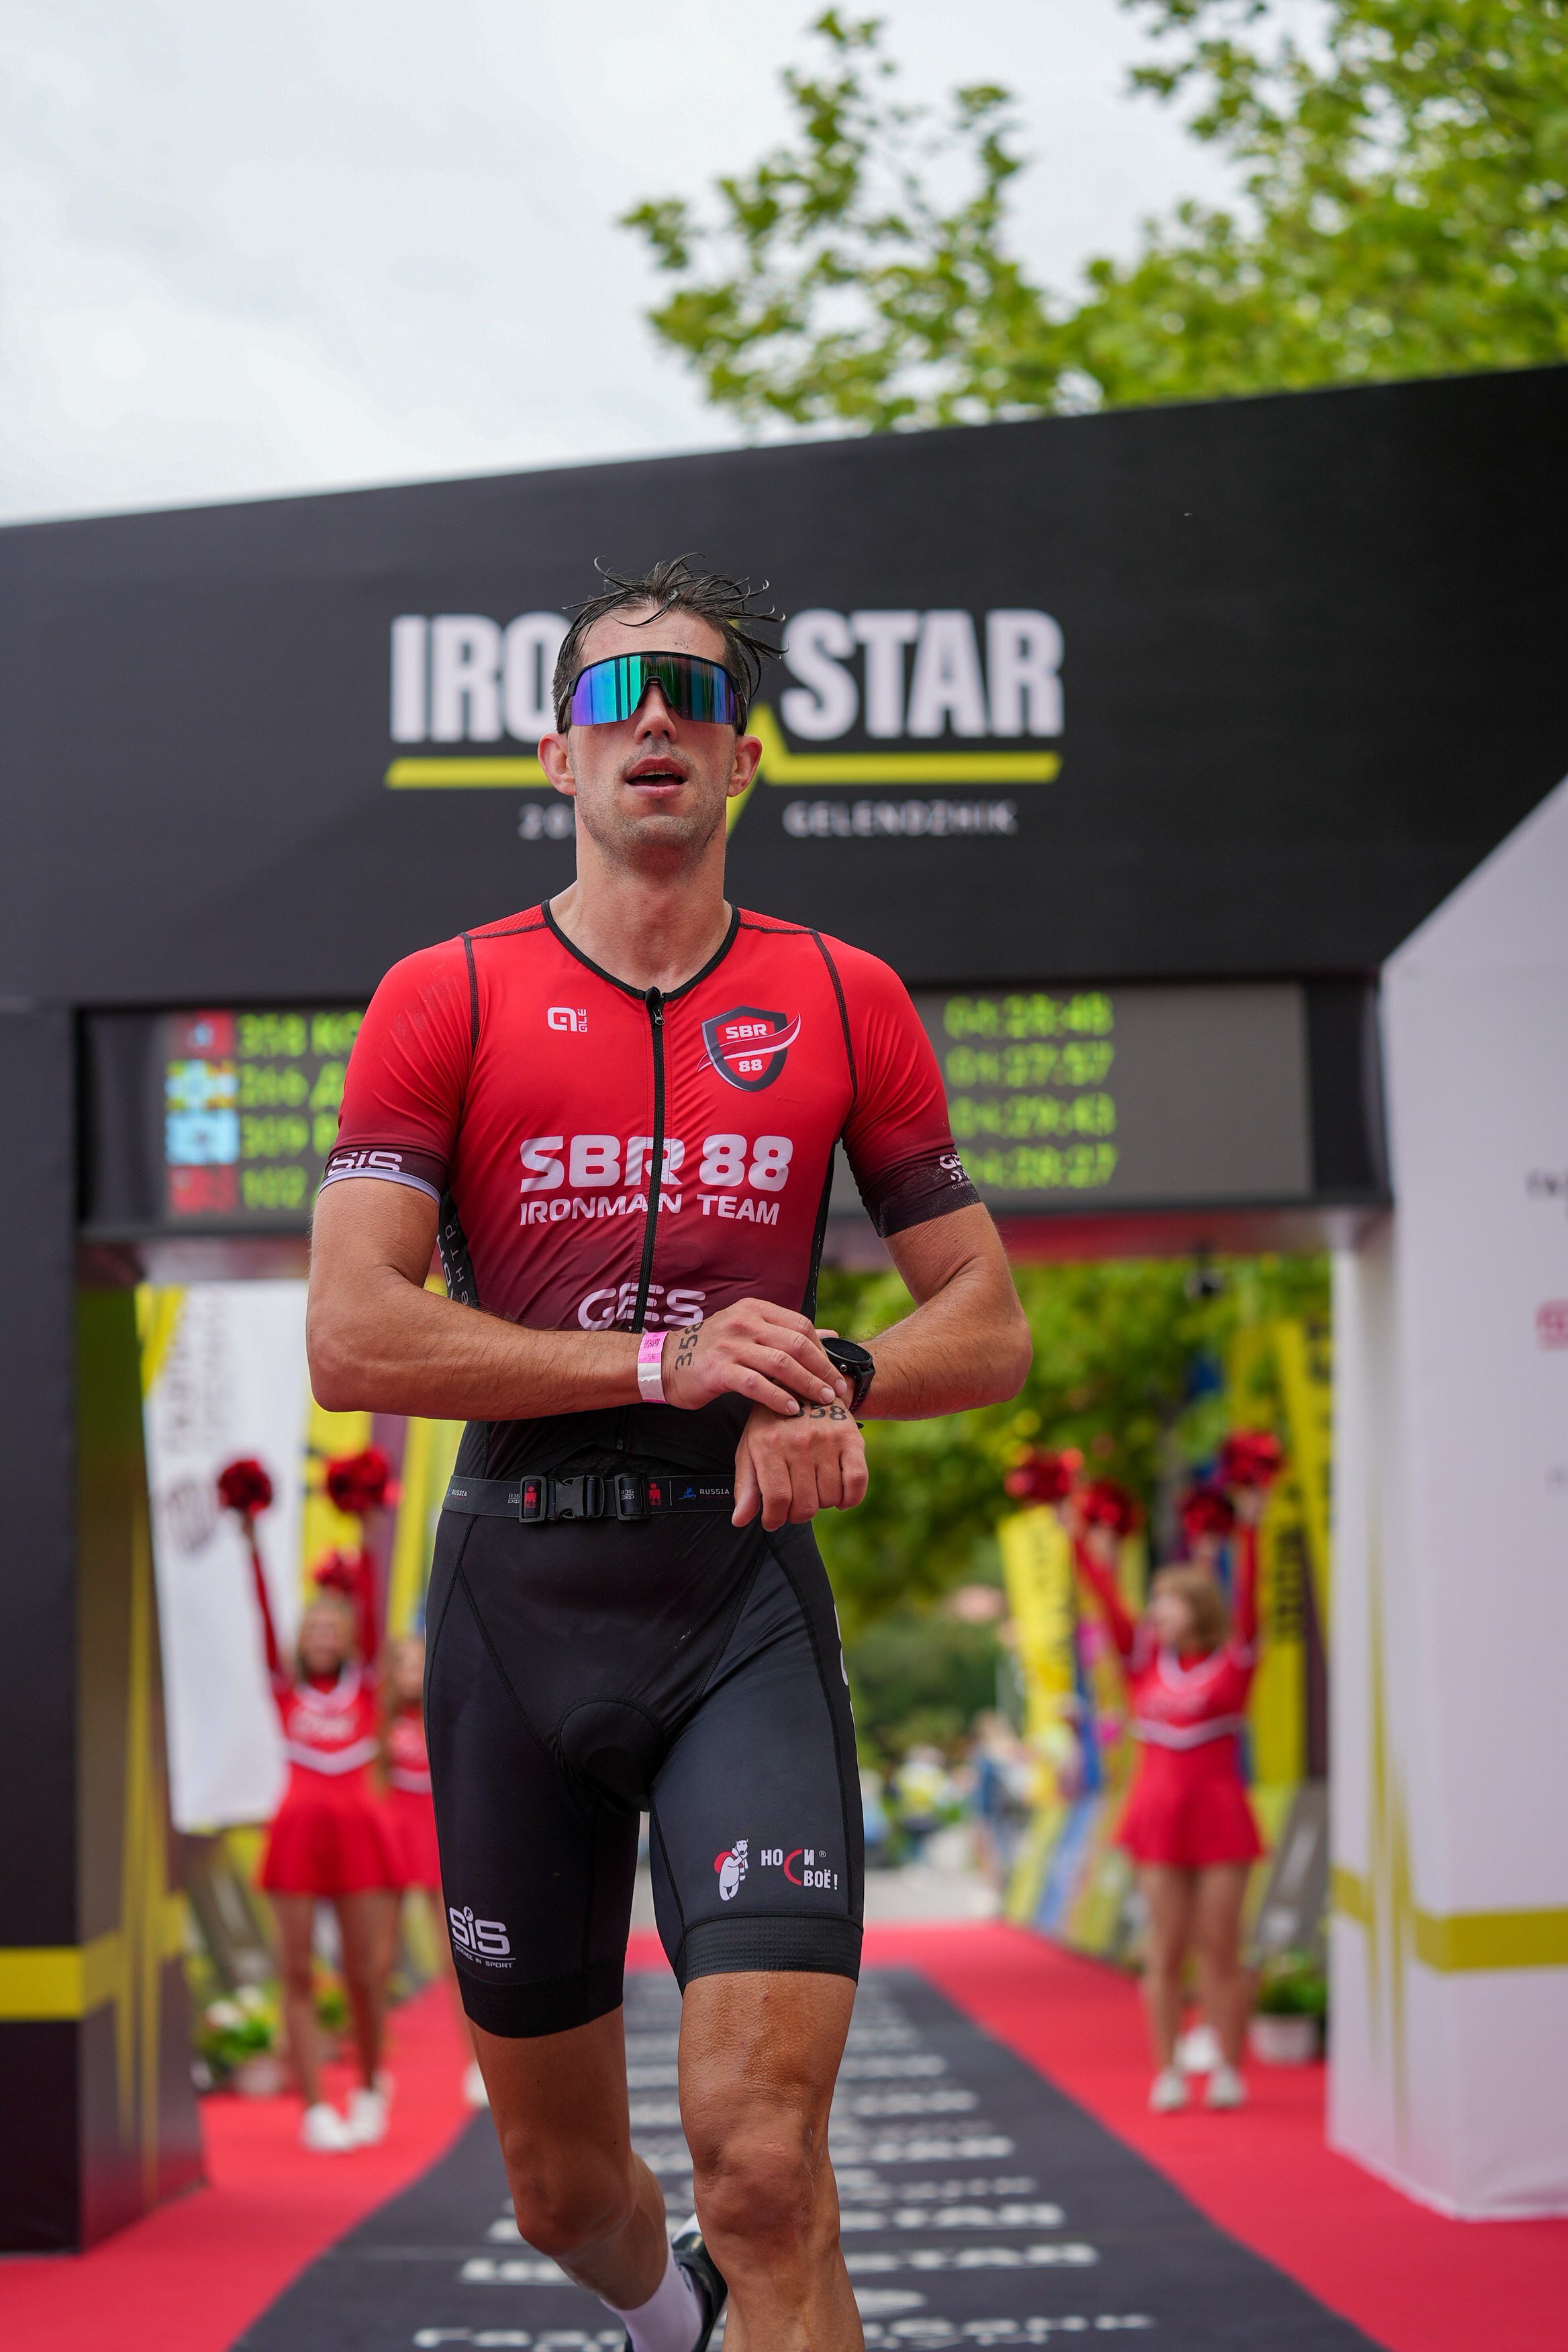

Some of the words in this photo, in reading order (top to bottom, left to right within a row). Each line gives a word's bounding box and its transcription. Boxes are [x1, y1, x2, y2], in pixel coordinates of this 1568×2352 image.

[781, 608, 1065, 741] STAR
[783, 801, 1018, 838] GELENDZHIK
[725, 1024, 767, 1040] SBR
[944, 991, 1114, 1040] 04:28:48
[738, 1059, 763, 1072] 88
[945, 1040, 1114, 1089] 04:27:57
[520, 1134, 685, 1193] SBR
[699, 1134, 793, 1192] 88
[520, 1193, 682, 1226] IRONMAN
[697, 1193, 780, 1226] TEAM
[578, 1282, 705, 1331] GES
[675, 1321, 705, 1370] 358
[449, 1906, 510, 1955] SiS
